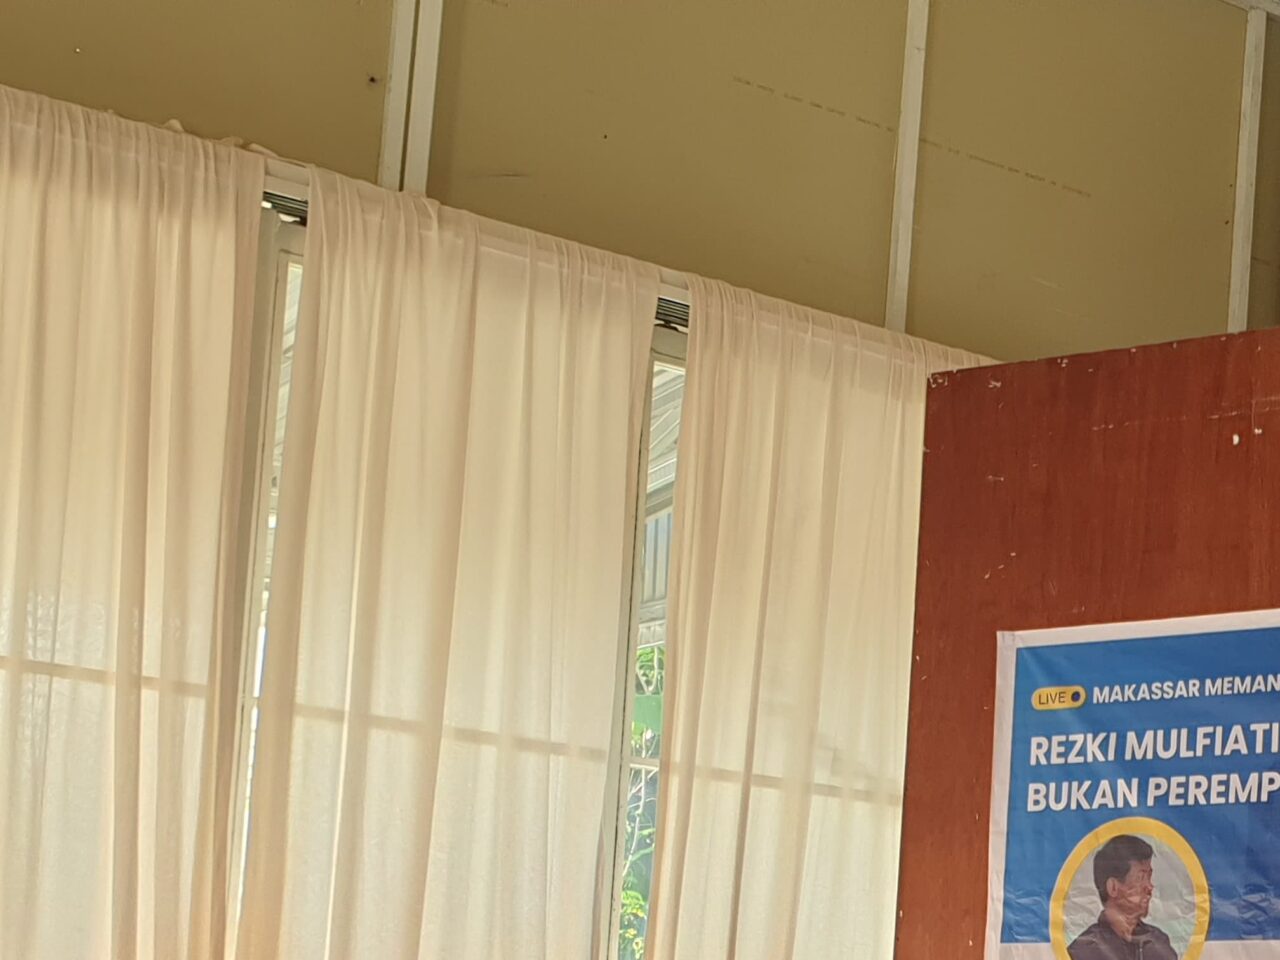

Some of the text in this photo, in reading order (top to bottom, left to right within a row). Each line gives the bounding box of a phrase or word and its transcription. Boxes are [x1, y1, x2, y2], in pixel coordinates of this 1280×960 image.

[1038, 691, 1067, 705] LIVE
[1092, 678, 1201, 704] MAKASSAR
[1029, 732, 1117, 766] REZKI
[1124, 721, 1280, 761] MULFIATI
[1026, 777, 1140, 812] BUKAN
